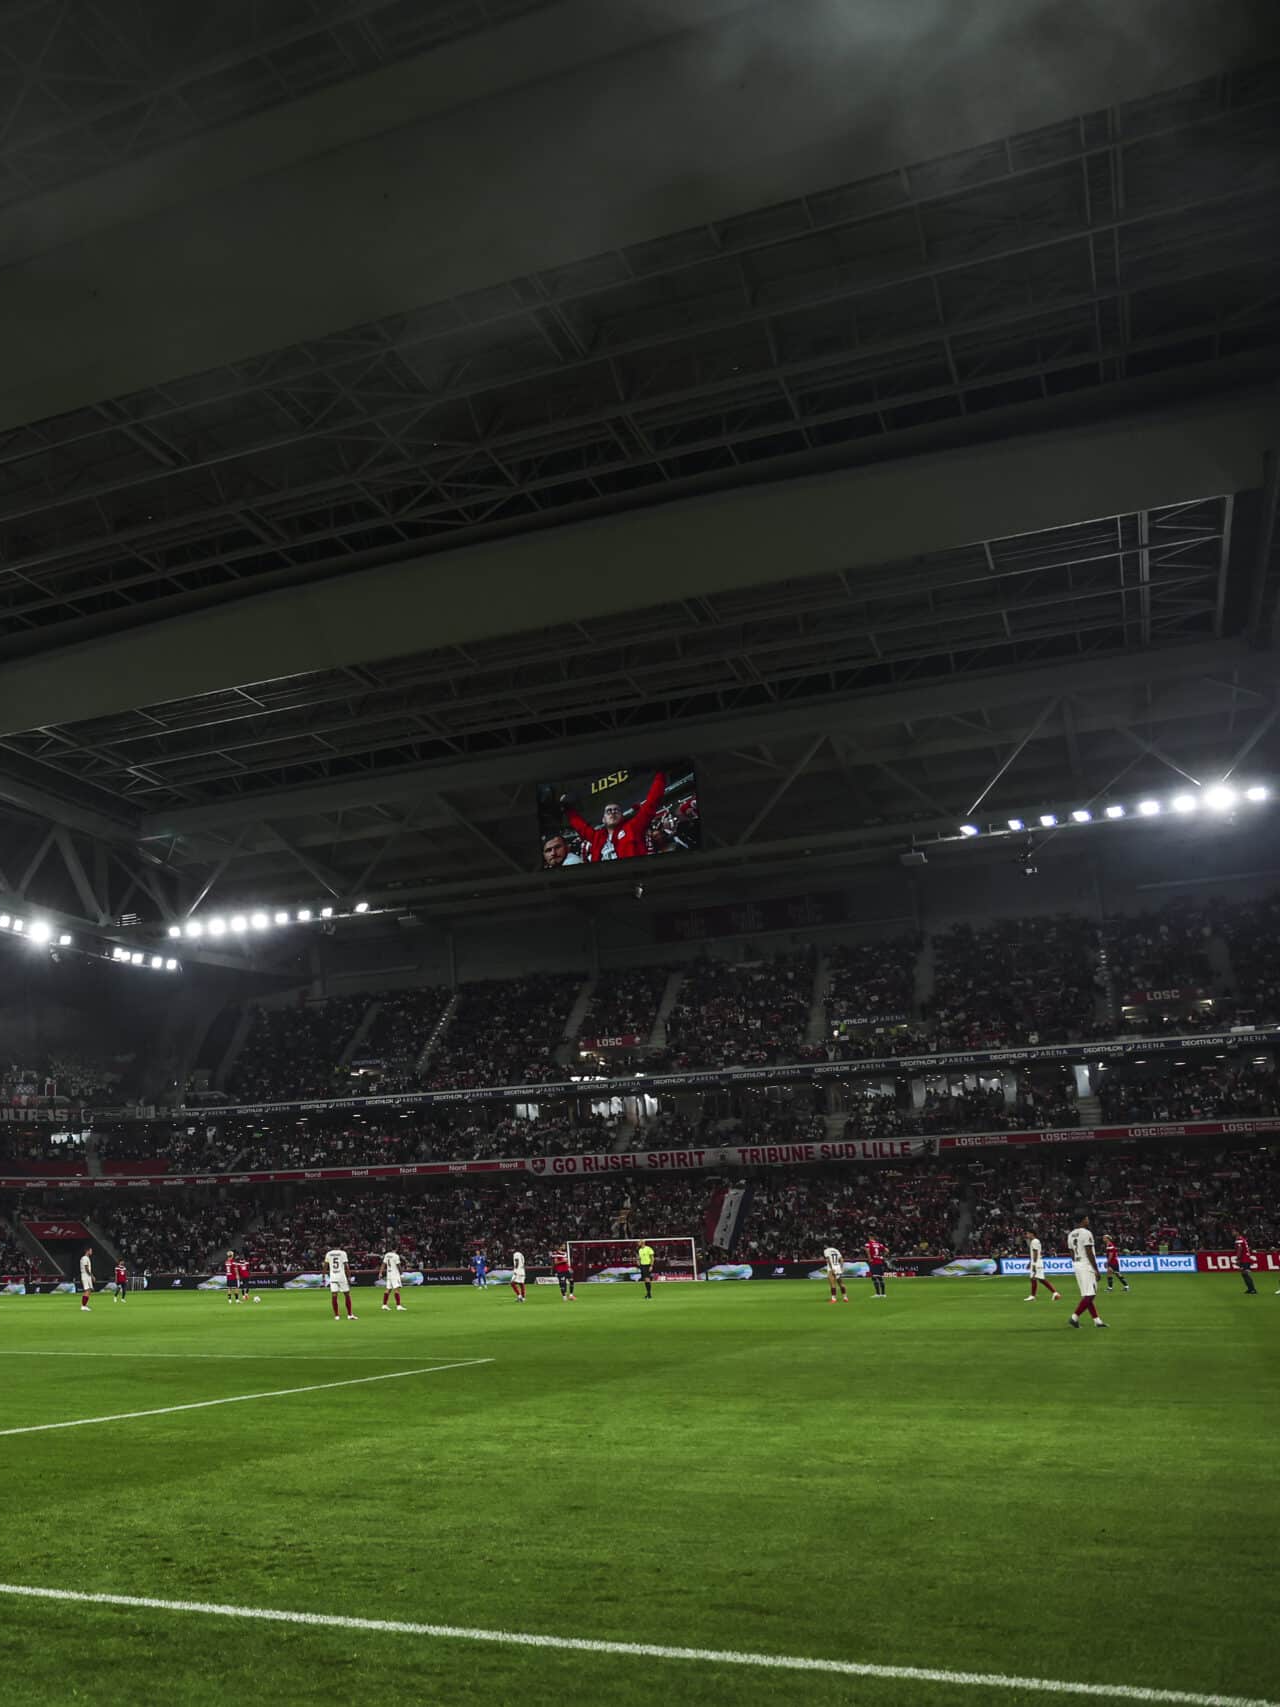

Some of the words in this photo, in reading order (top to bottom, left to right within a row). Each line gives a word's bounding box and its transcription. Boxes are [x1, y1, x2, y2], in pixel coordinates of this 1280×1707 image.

[592, 770, 629, 794] LOSC
[1146, 989, 1180, 1001] LOSC
[597, 1037, 622, 1047] LOSC
[1181, 1038, 1223, 1048] DECATHLON
[1235, 1035, 1267, 1044] ARENA
[1083, 1045, 1124, 1054] DECATHLON
[1135, 1042, 1165, 1050] ARENA
[989, 1052, 1027, 1061] DECATHLON
[1040, 1049, 1068, 1057] ARENA
[900, 1058, 937, 1067] DECATHLON
[945, 1056, 975, 1064] ARENA
[1223, 1123, 1252, 1132] LOSC
[1128, 1128, 1156, 1137] LOSC
[956, 1136, 982, 1146] LOSC
[1040, 1133, 1067, 1142] LOSC
[553, 1158, 577, 1173] GO
[582, 1154, 641, 1172] RIJSEL
[648, 1151, 705, 1168] SPIRIT
[737, 1145, 814, 1165] TRIBUNE
[821, 1143, 856, 1160] SUD
[863, 1141, 912, 1159] LILLE
[400, 1166, 417, 1174] Nord
[449, 1163, 467, 1172] Nord
[305, 1171, 321, 1179] Nord
[352, 1169, 369, 1177] Nord
[333, 1257, 339, 1269] 5
[1005, 1261, 1028, 1270] Nor
[1043, 1261, 1072, 1270] Nord
[1120, 1259, 1151, 1268] Nord
[1160, 1258, 1191, 1267] Nord
